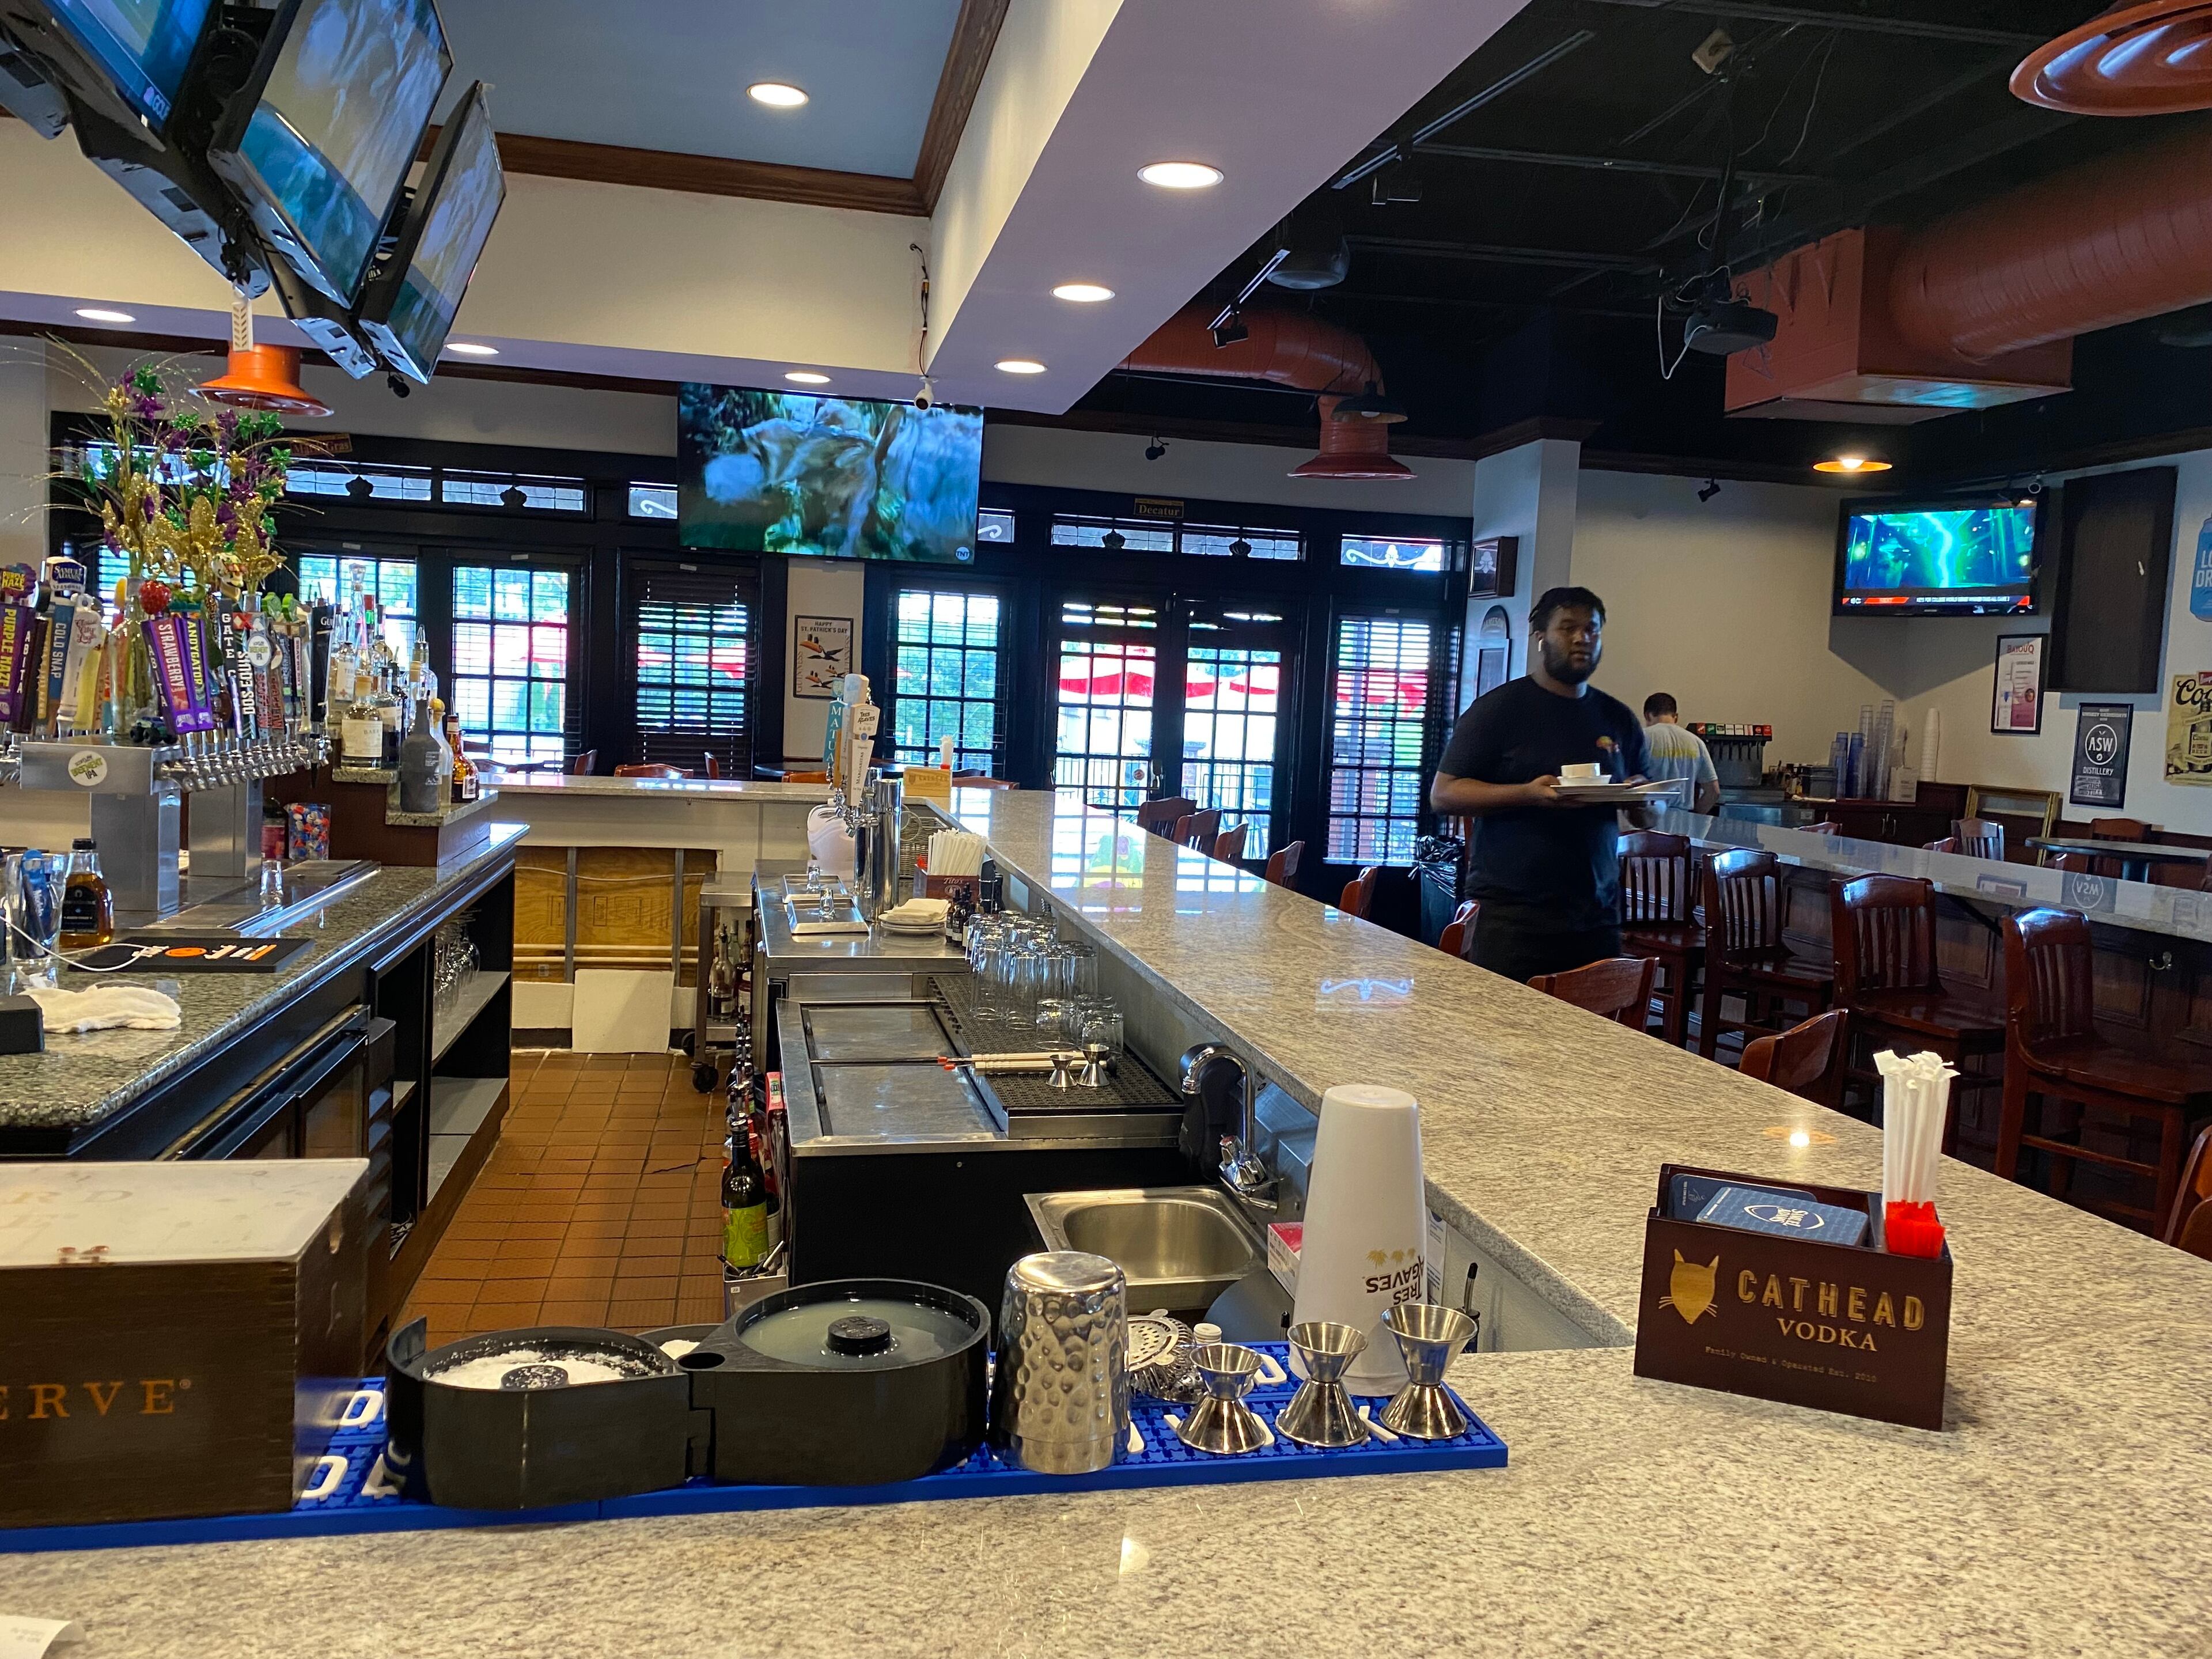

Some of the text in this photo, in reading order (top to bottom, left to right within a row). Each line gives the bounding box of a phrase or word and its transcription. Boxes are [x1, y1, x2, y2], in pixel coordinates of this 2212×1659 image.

[1139, 505, 1180, 516] Decatur
[956, 550, 970, 559] TNT
[2, 571, 25, 579] PURPLE
[2, 578, 24, 588] HAZE
[0, 608, 17, 688] PURPLE HAZE
[51, 623, 67, 679] COLD SNAP
[222, 613, 234, 658] GATE
[17, 631, 30, 693] ABITA
[158, 624, 185, 688] STRAWBERRY
[187, 621, 203, 685] ANDYGATOR
[148, 645, 168, 708] ABITA
[240, 691, 256, 715] DOS
[827, 705, 841, 762] MATUA
[857, 716, 876, 724] AGAVES
[2088, 737, 2113, 752] ASW
[85, 769, 98, 779] IPA
[855, 752, 864, 784] MARGARITAS
[2082, 767, 2114, 776] DISTILLERY
[1365, 1255, 1425, 1293] AGAVES
[1393, 1275, 1422, 1305] TRES
[1738, 1269, 1925, 1331] CATHEAD
[1777, 1317, 1878, 1352] VODKA
[1705, 1346, 1736, 1359] Family
[1781, 1359, 1824, 1373] Operated
[1829, 1368, 1849, 1378] Est.
